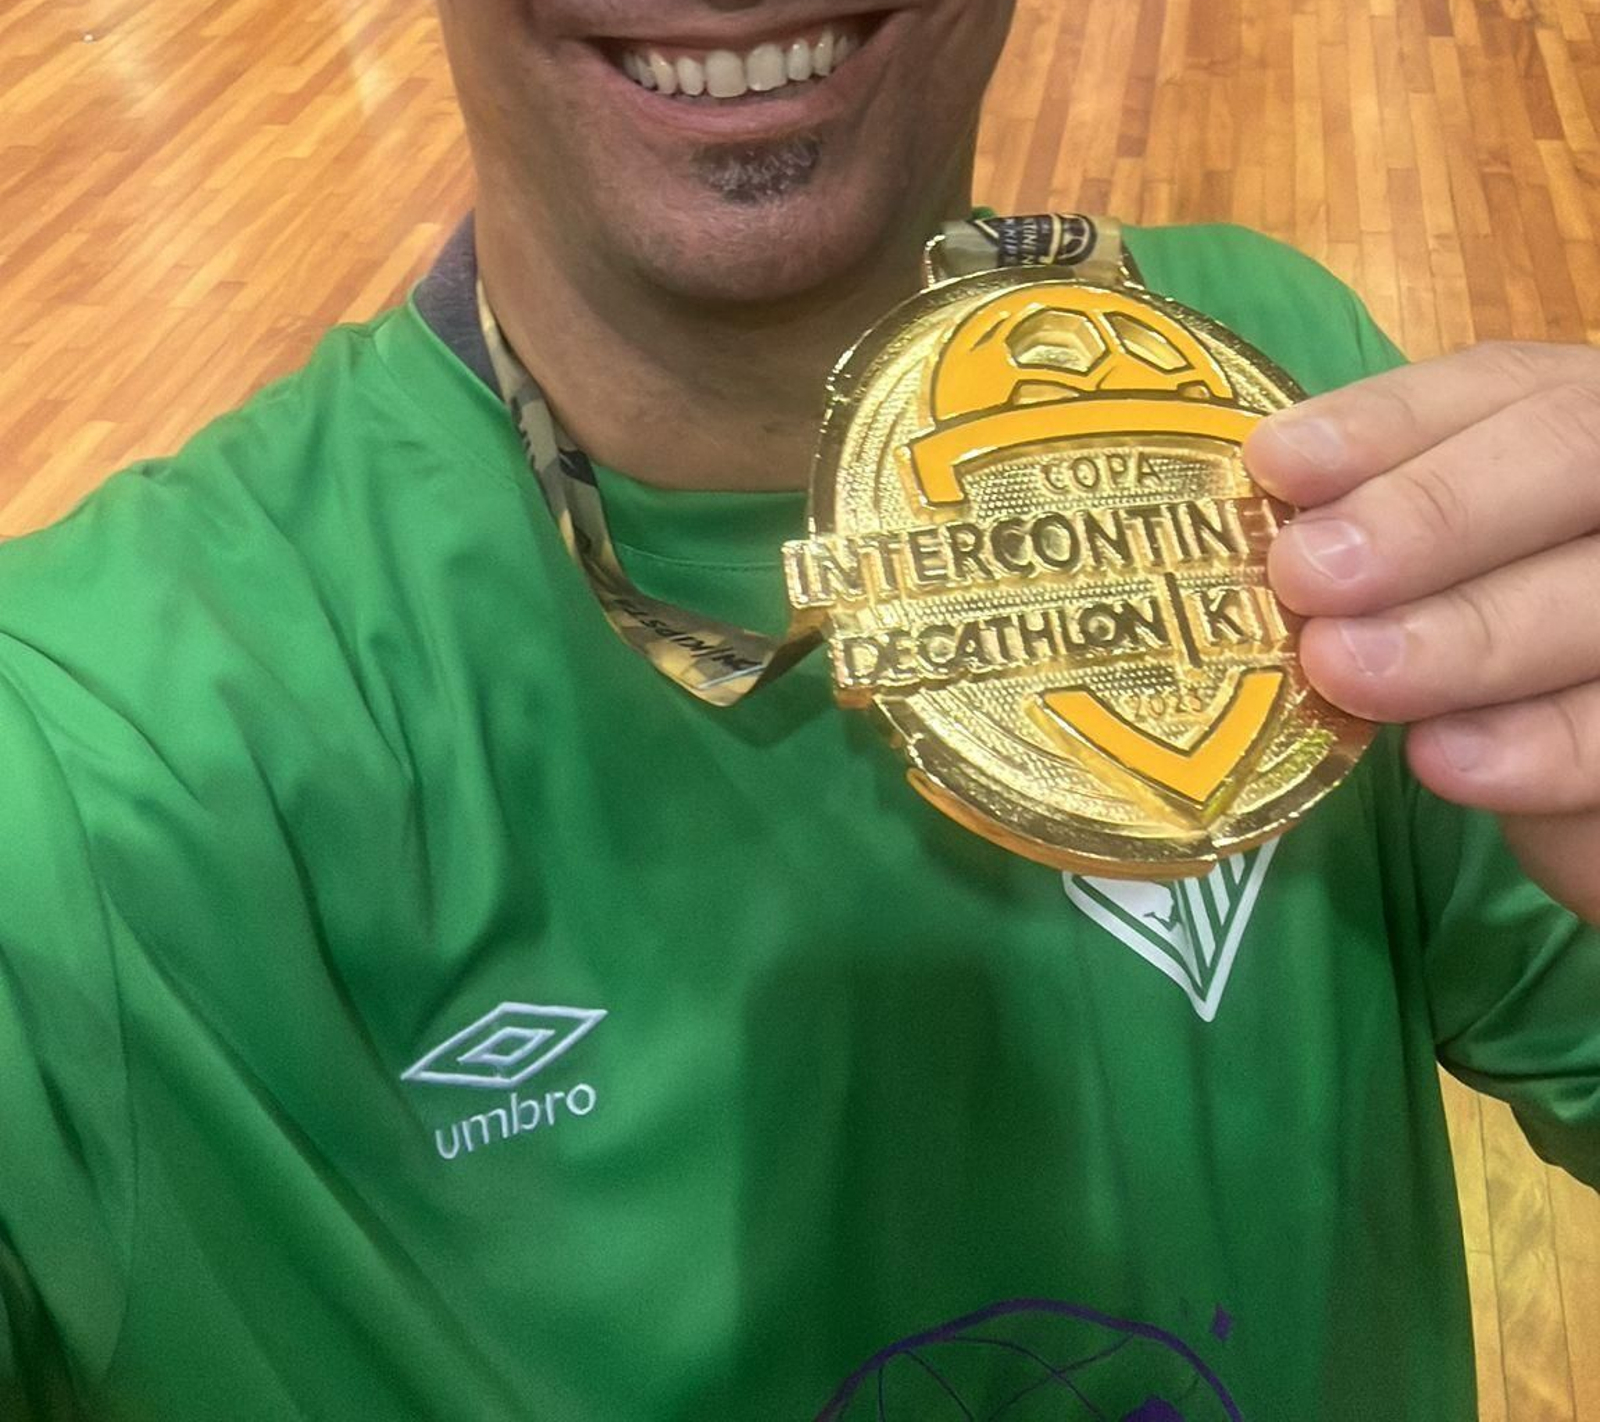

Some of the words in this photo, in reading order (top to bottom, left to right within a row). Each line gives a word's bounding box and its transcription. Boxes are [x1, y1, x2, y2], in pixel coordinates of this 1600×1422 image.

[1042, 451, 1162, 493] COPA
[843, 595, 1173, 682] DECATHLON
[436, 1083, 597, 1160] umbro
